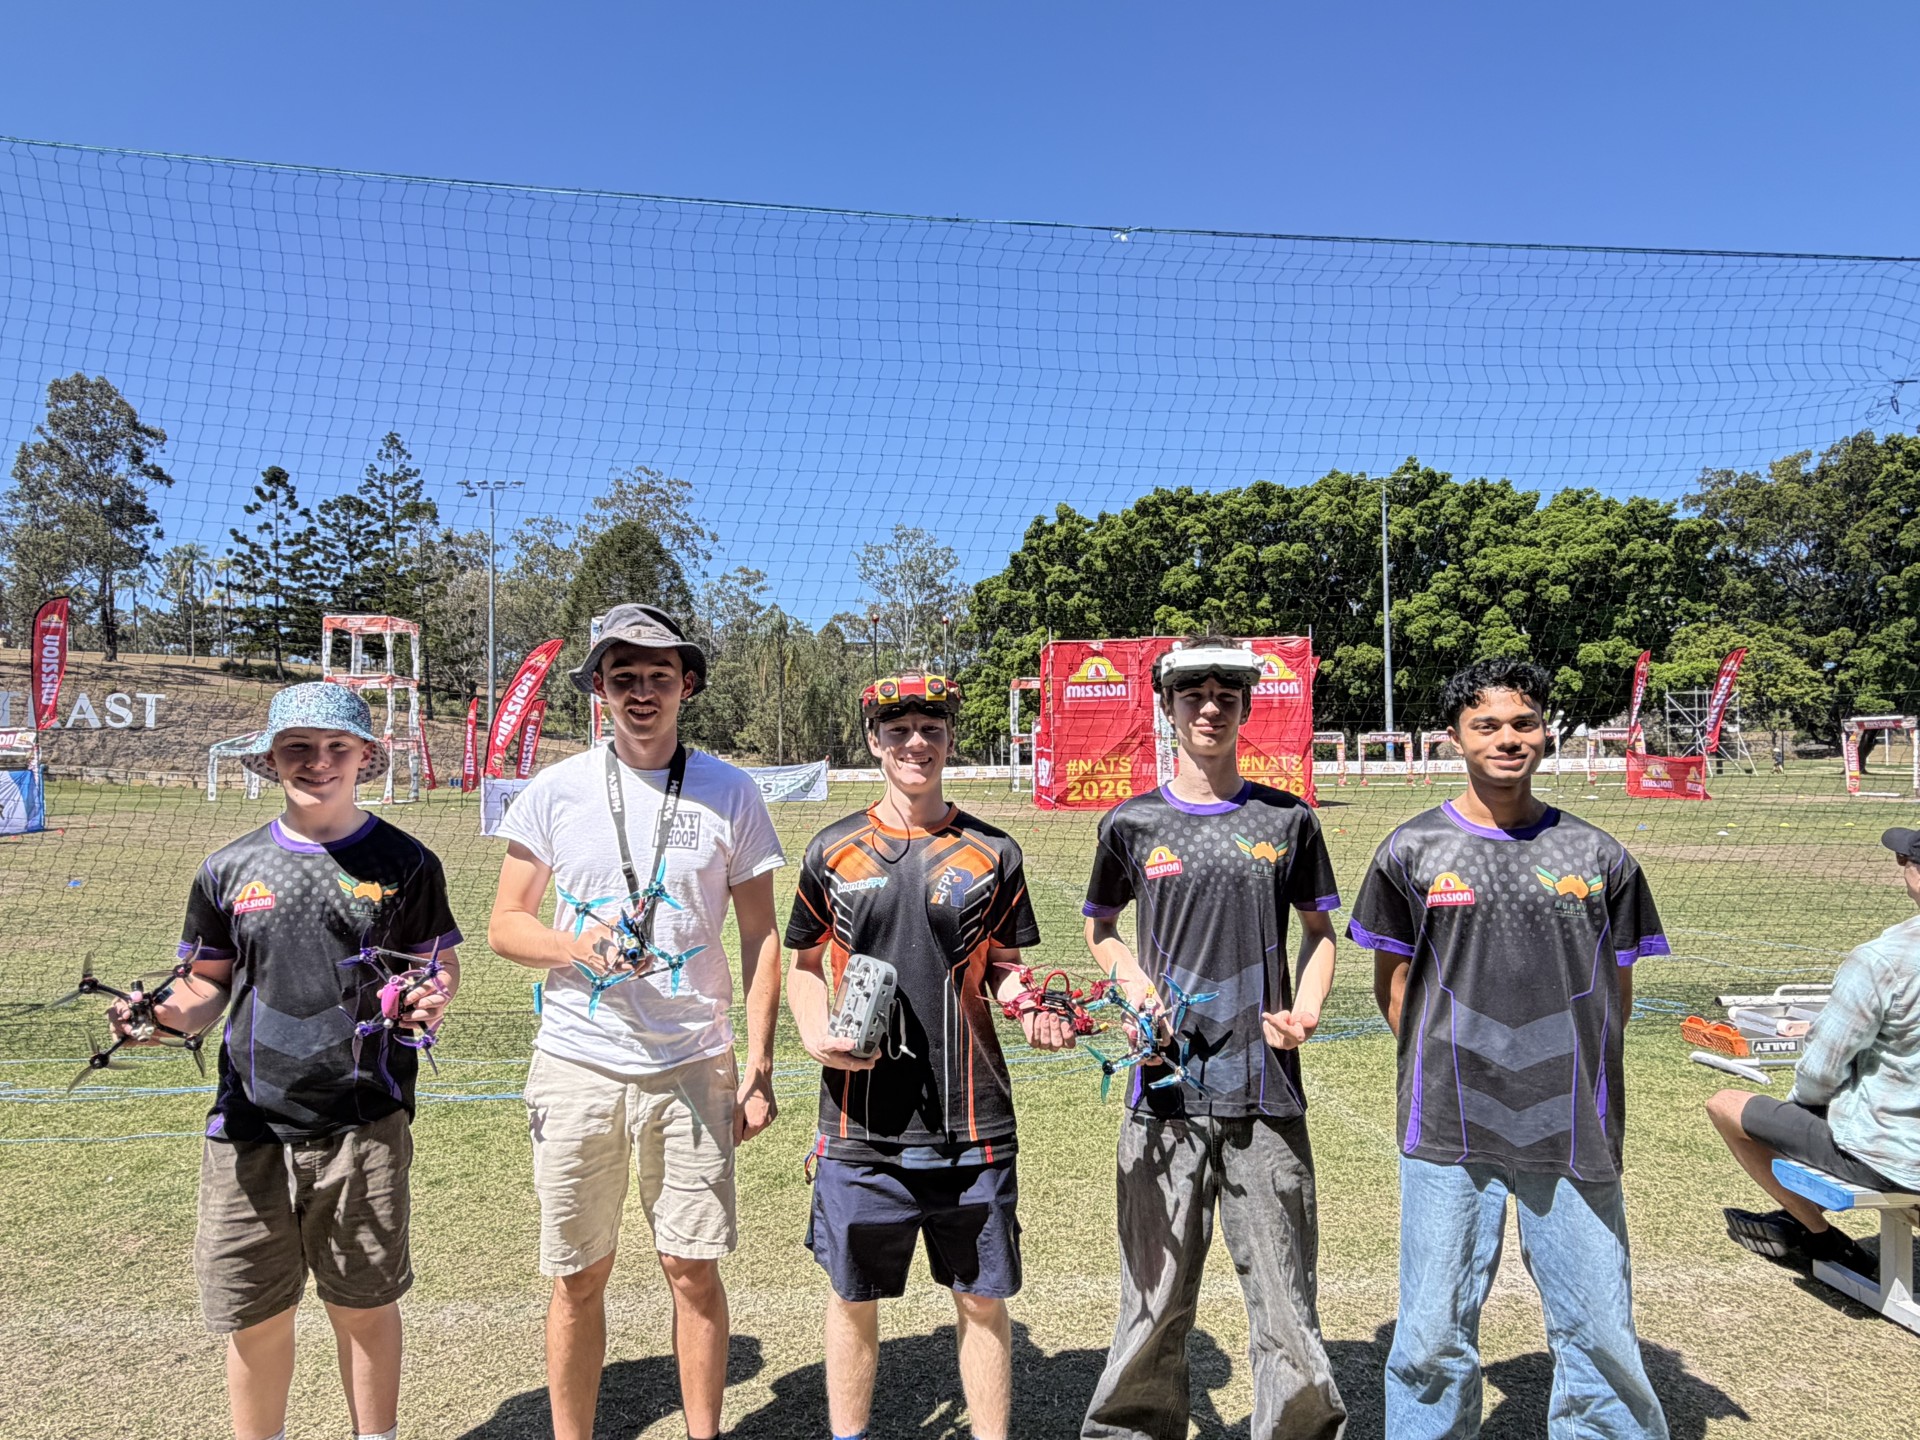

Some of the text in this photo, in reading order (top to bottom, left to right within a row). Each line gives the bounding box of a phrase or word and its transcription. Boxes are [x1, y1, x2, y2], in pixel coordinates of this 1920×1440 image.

[1066, 757, 1132, 775] #NATS
[1239, 755, 1303, 772] #NATS
[1066, 779, 1133, 802] 2026
[1755, 1041, 1796, 1052] BAILEY
